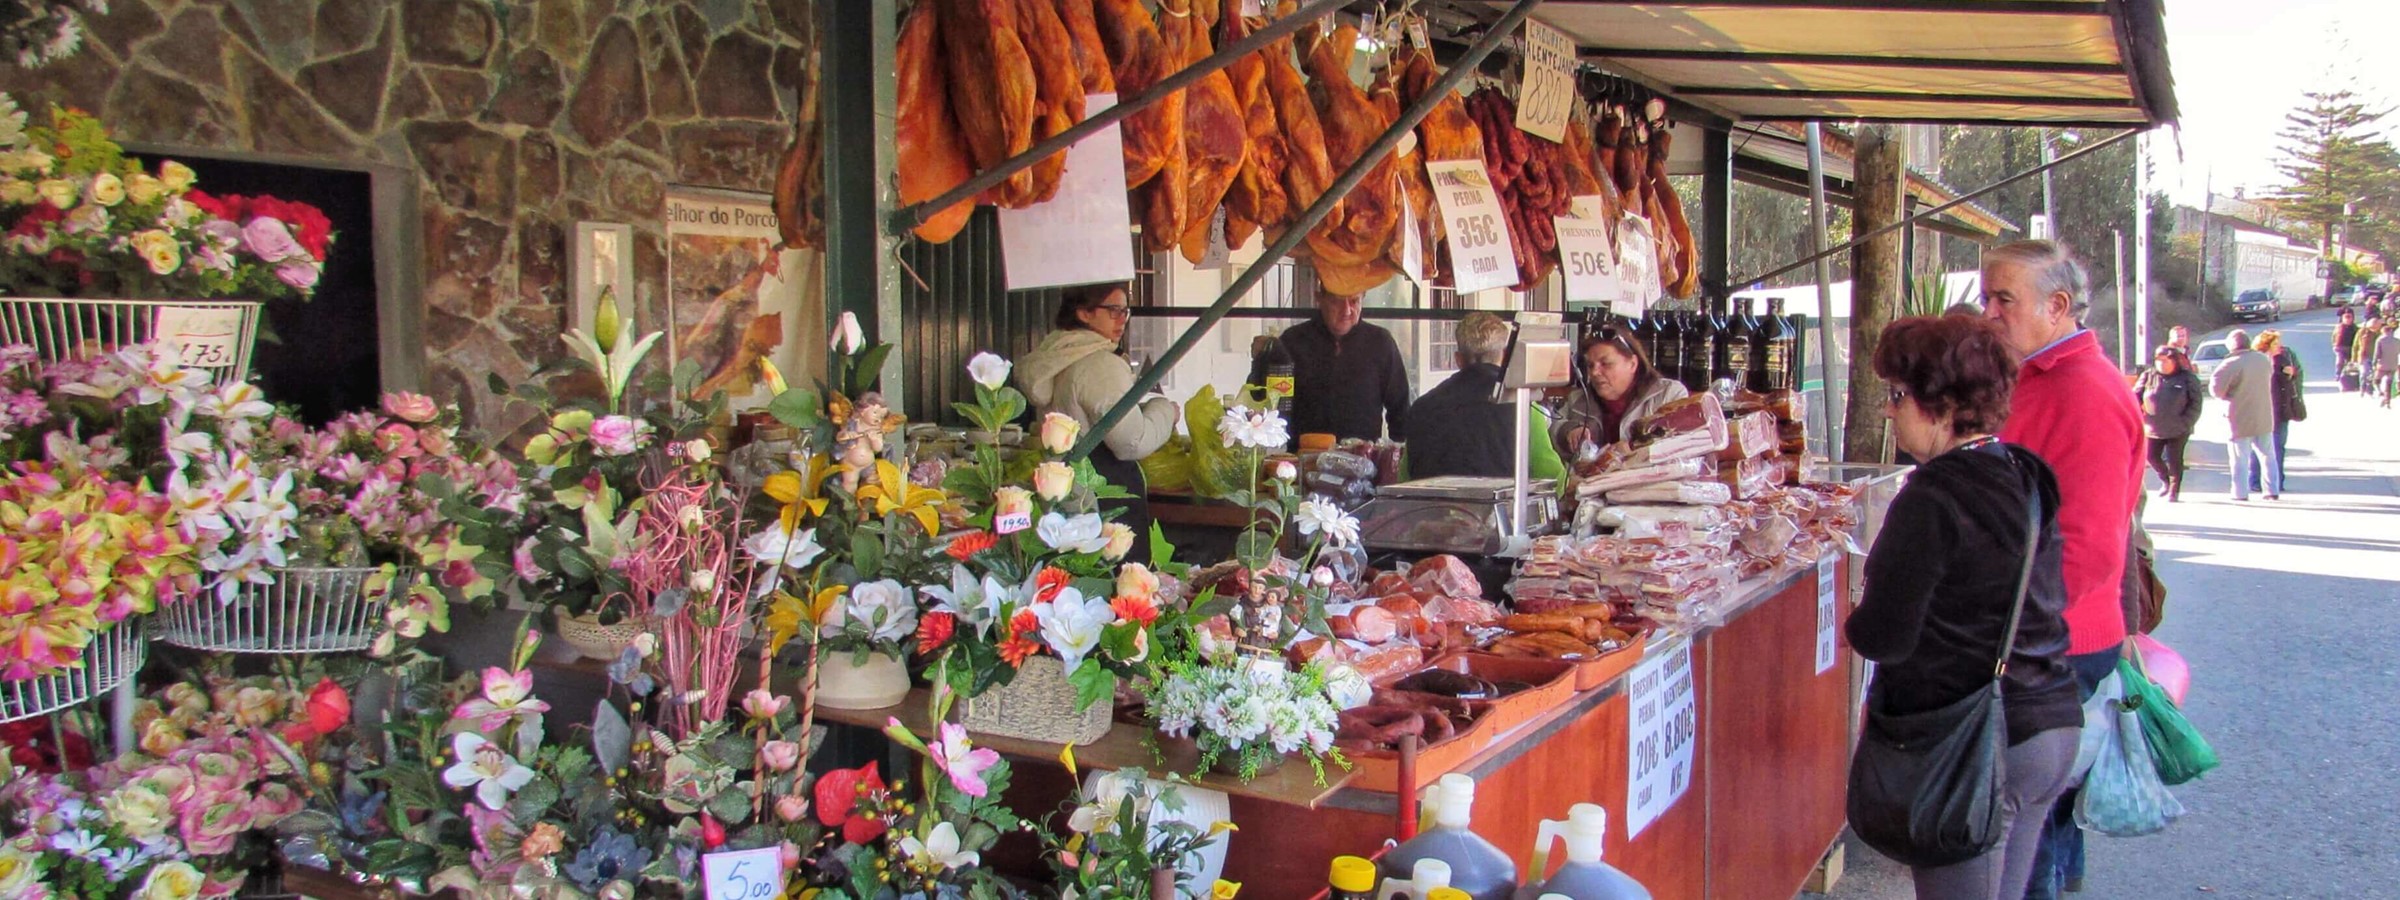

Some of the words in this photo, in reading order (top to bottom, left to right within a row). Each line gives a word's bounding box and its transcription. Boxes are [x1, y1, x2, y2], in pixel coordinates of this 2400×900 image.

[1453, 190, 1484, 206] PERNA
[710, 206, 729, 225] do
[735, 207, 777, 228] Porco
[1456, 214, 1498, 249] 35€
[1561, 227, 1601, 238] PRESUNTO
[1472, 256, 1498, 274] CADA
[1570, 252, 1609, 276] 50€
[1633, 668, 1658, 703] PRESUNTO
[1636, 730, 1659, 781] 20€
[1670, 760, 1683, 796] KG
[1638, 784, 1653, 810] CADA
